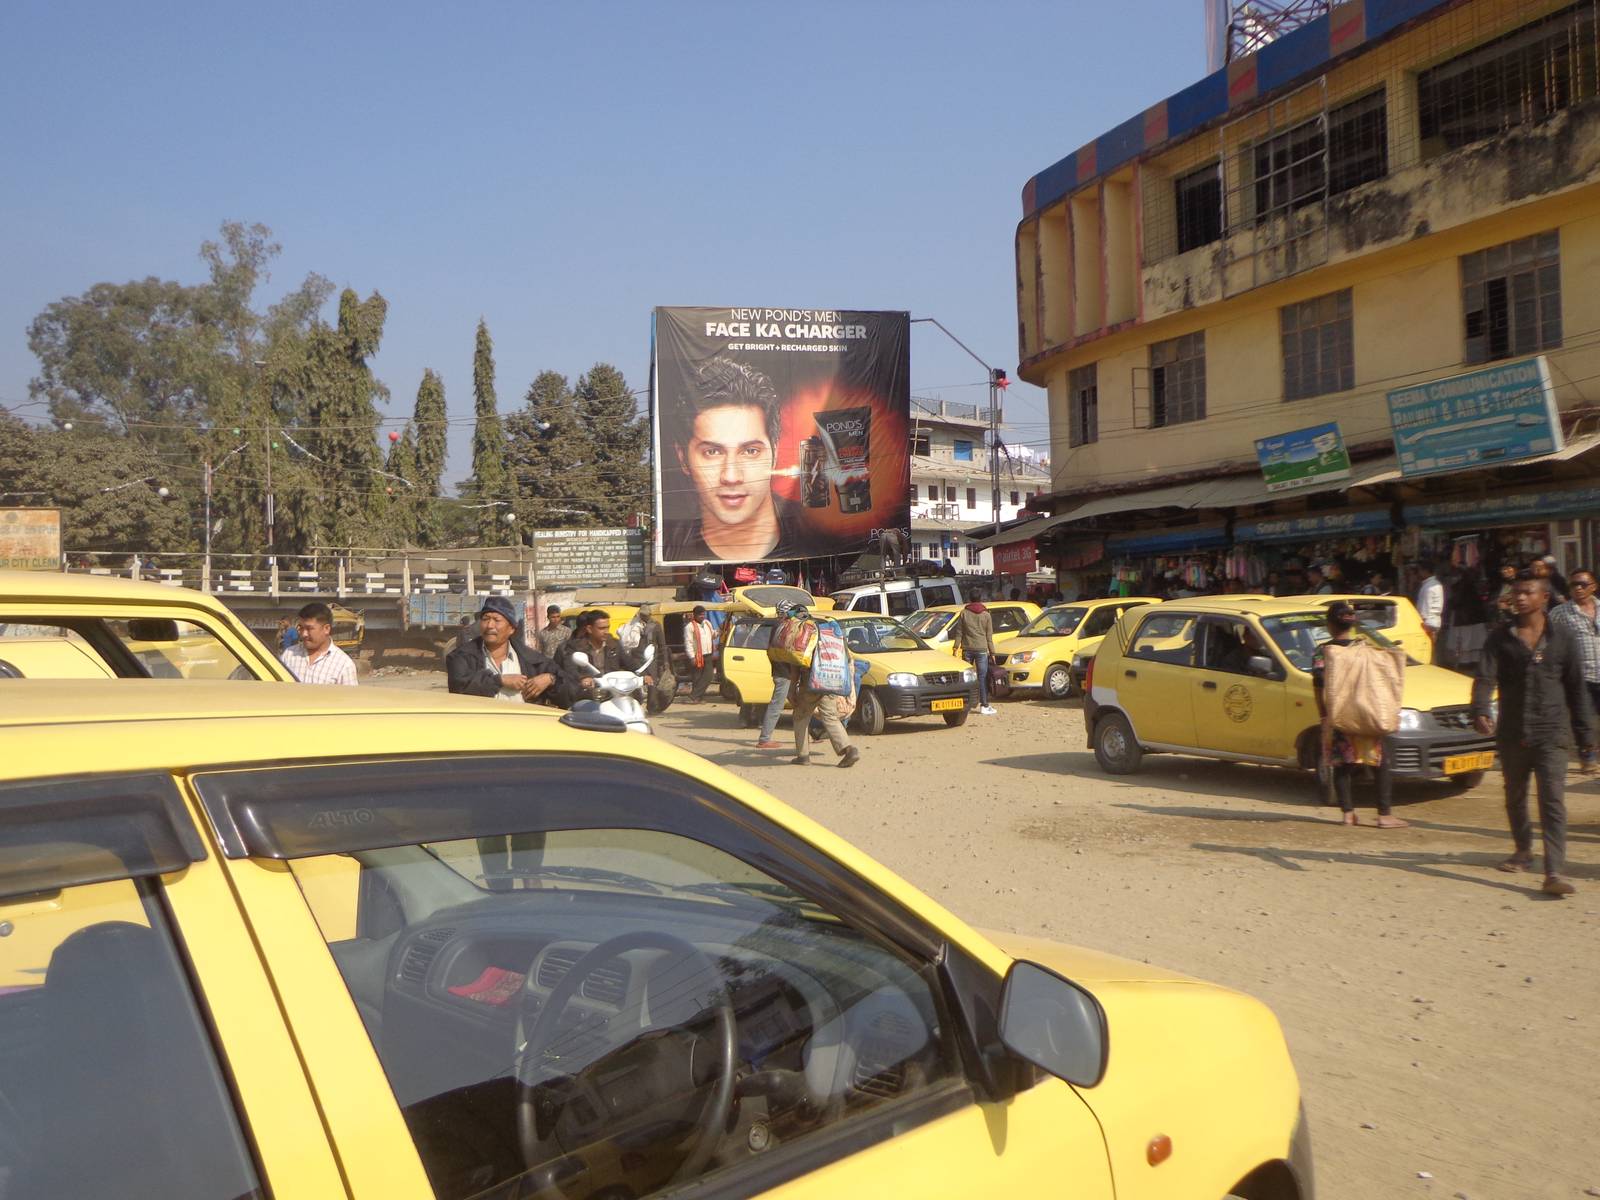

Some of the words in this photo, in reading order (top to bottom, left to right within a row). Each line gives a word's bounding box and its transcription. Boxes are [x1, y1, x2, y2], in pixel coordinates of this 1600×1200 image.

[731, 309, 761, 321] NEW
[765, 310, 812, 322] POND'S
[814, 311, 842, 323] MEN
[705, 322, 751, 337] FACE
[755, 323, 782, 338] KA
[784, 323, 867, 339] CHARGER
[728, 343, 745, 351] GET
[745, 343, 775, 351] BRIGHT
[781, 344, 828, 352] RECHARGED
[829, 344, 847, 352] SKIN
[1429, 364, 1537, 399] COMMUNICATION
[1441, 401, 1453, 420] &
[1457, 397, 1477, 418] AIR
[826, 420, 863, 432] POND'S
[589, 529, 622, 537] HANDICAPPED
[11, 558, 30, 569] CITY
[308, 808, 374, 828] ALTO
